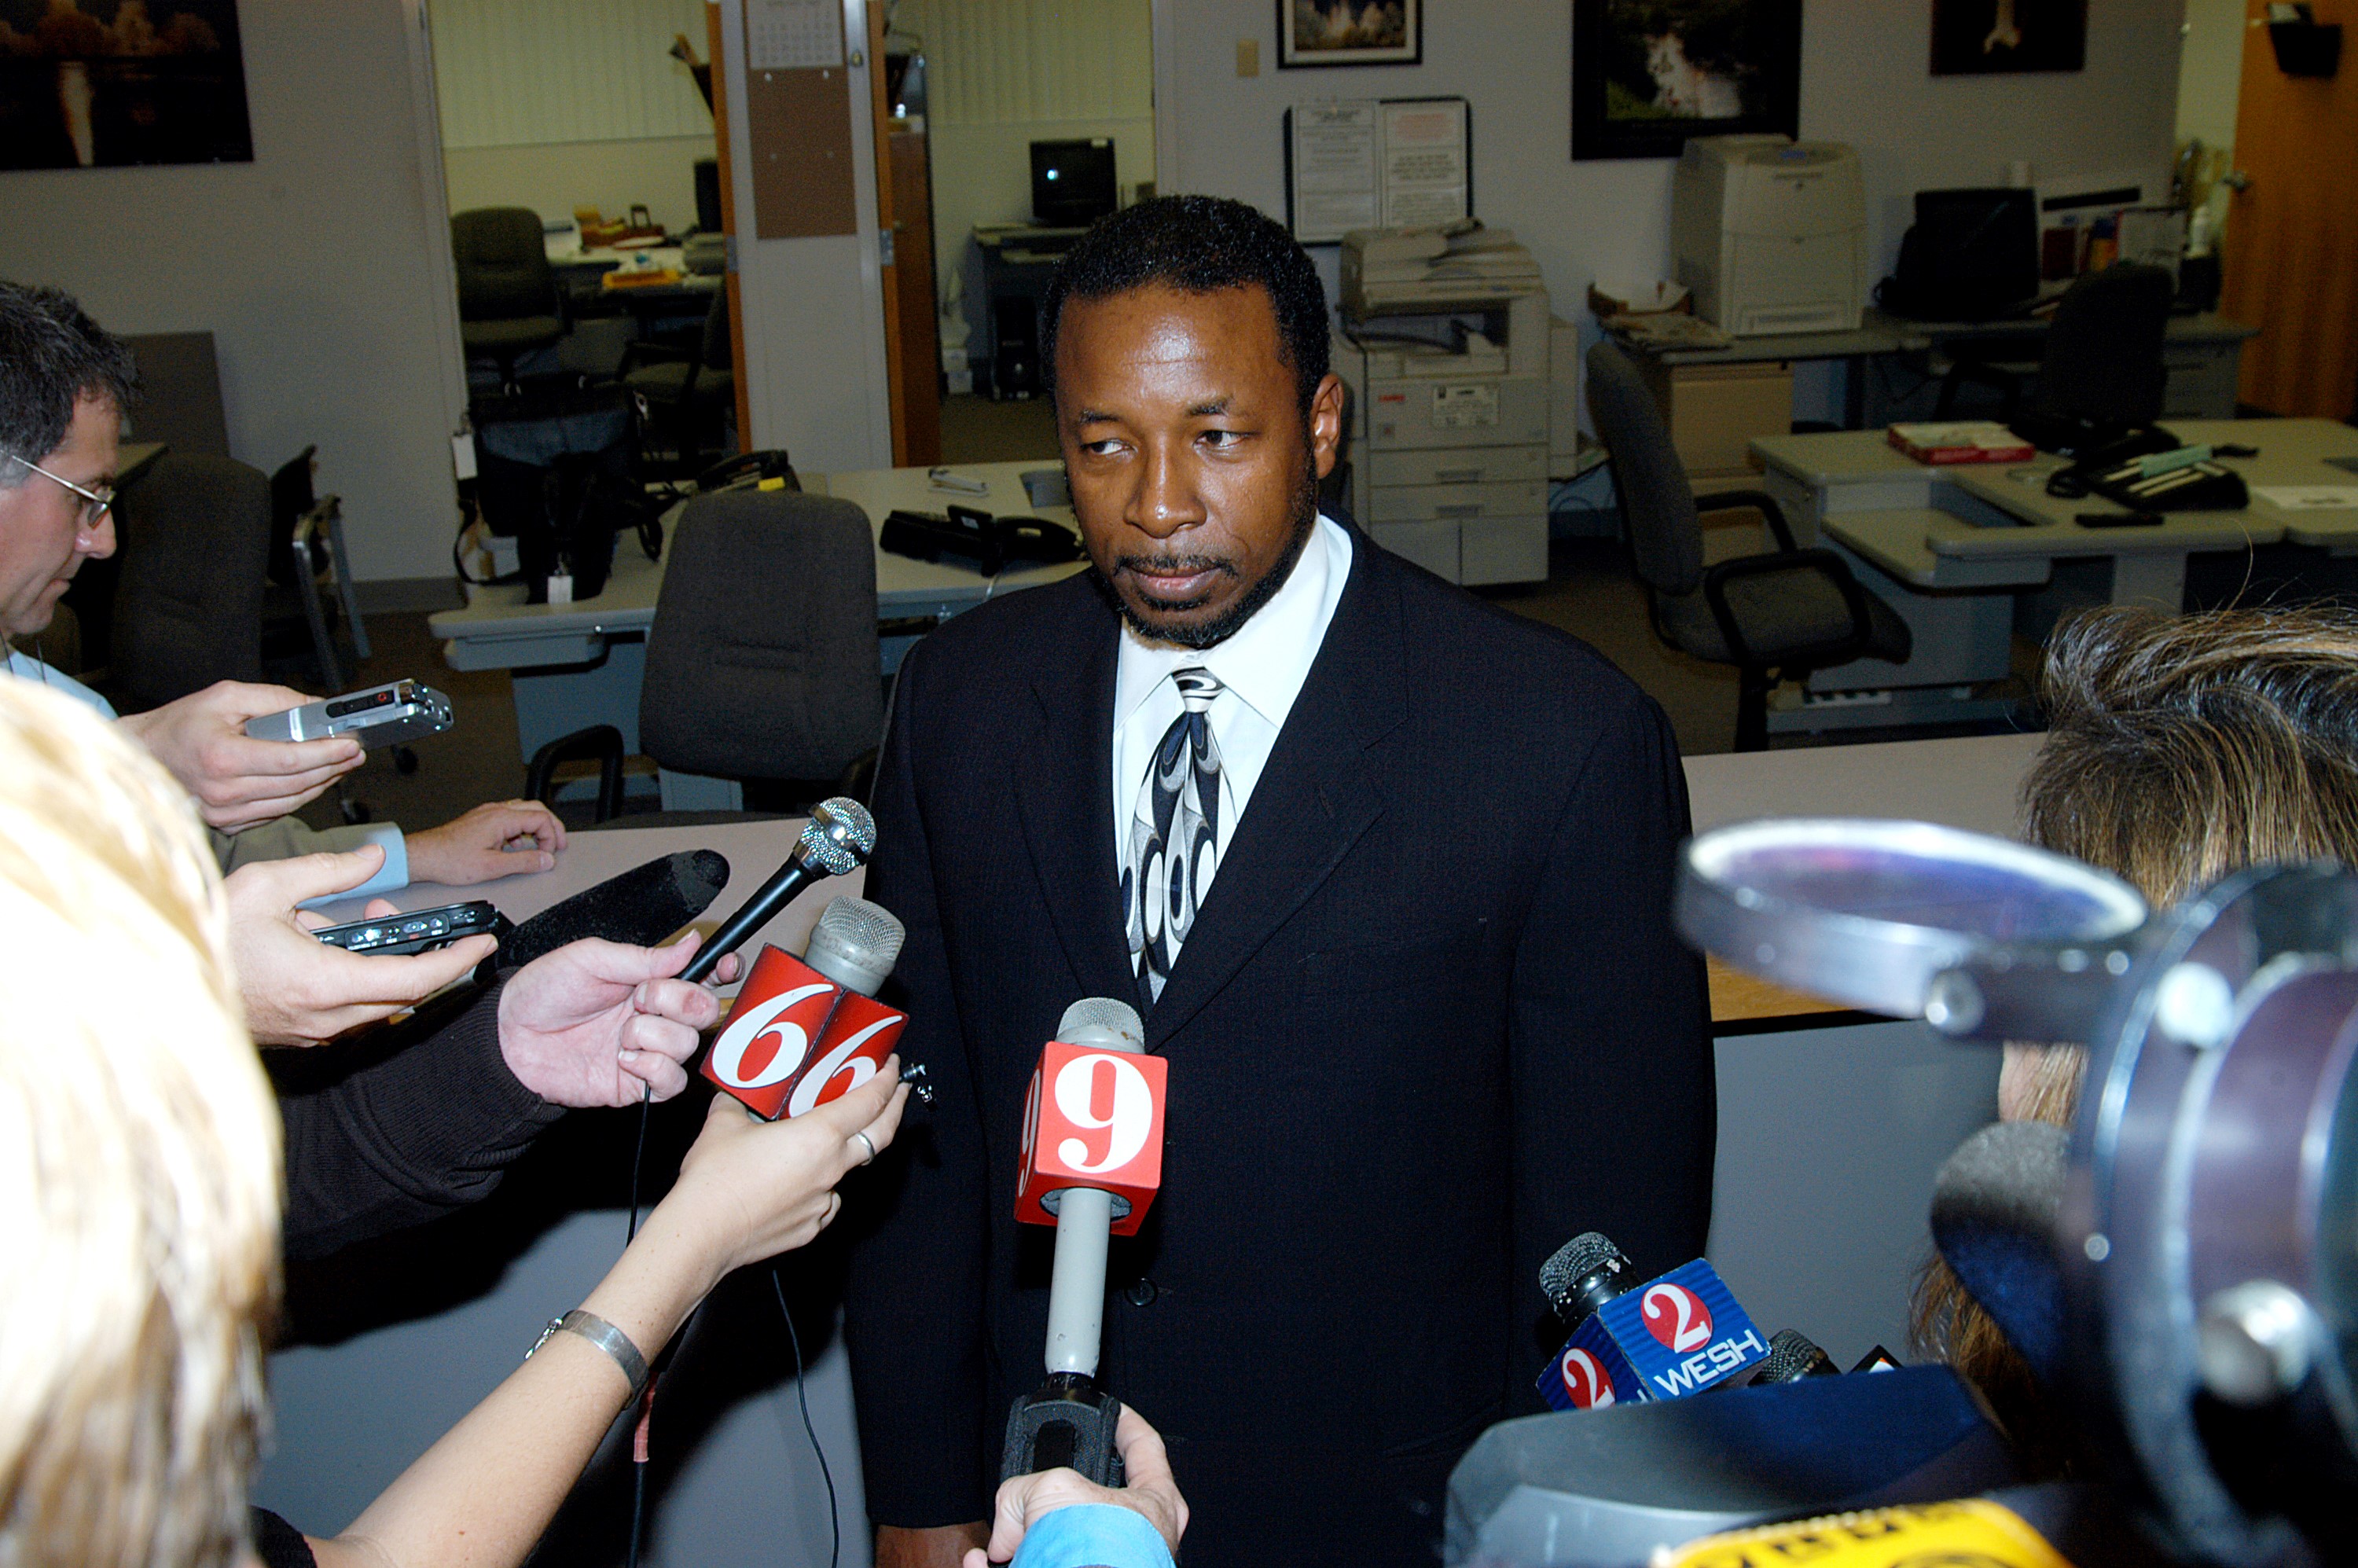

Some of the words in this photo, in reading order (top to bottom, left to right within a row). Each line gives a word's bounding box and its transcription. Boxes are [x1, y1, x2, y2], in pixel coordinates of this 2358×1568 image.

[712, 984, 834, 1089] 6
[789, 1015, 903, 1118] 6
[1019, 1069, 1041, 1197] 9
[1054, 1054, 1153, 1173] 9
[1644, 1283, 1712, 1354] 2
[1653, 1329, 1765, 1397] WESH
[1562, 1348, 1616, 1410] 2
